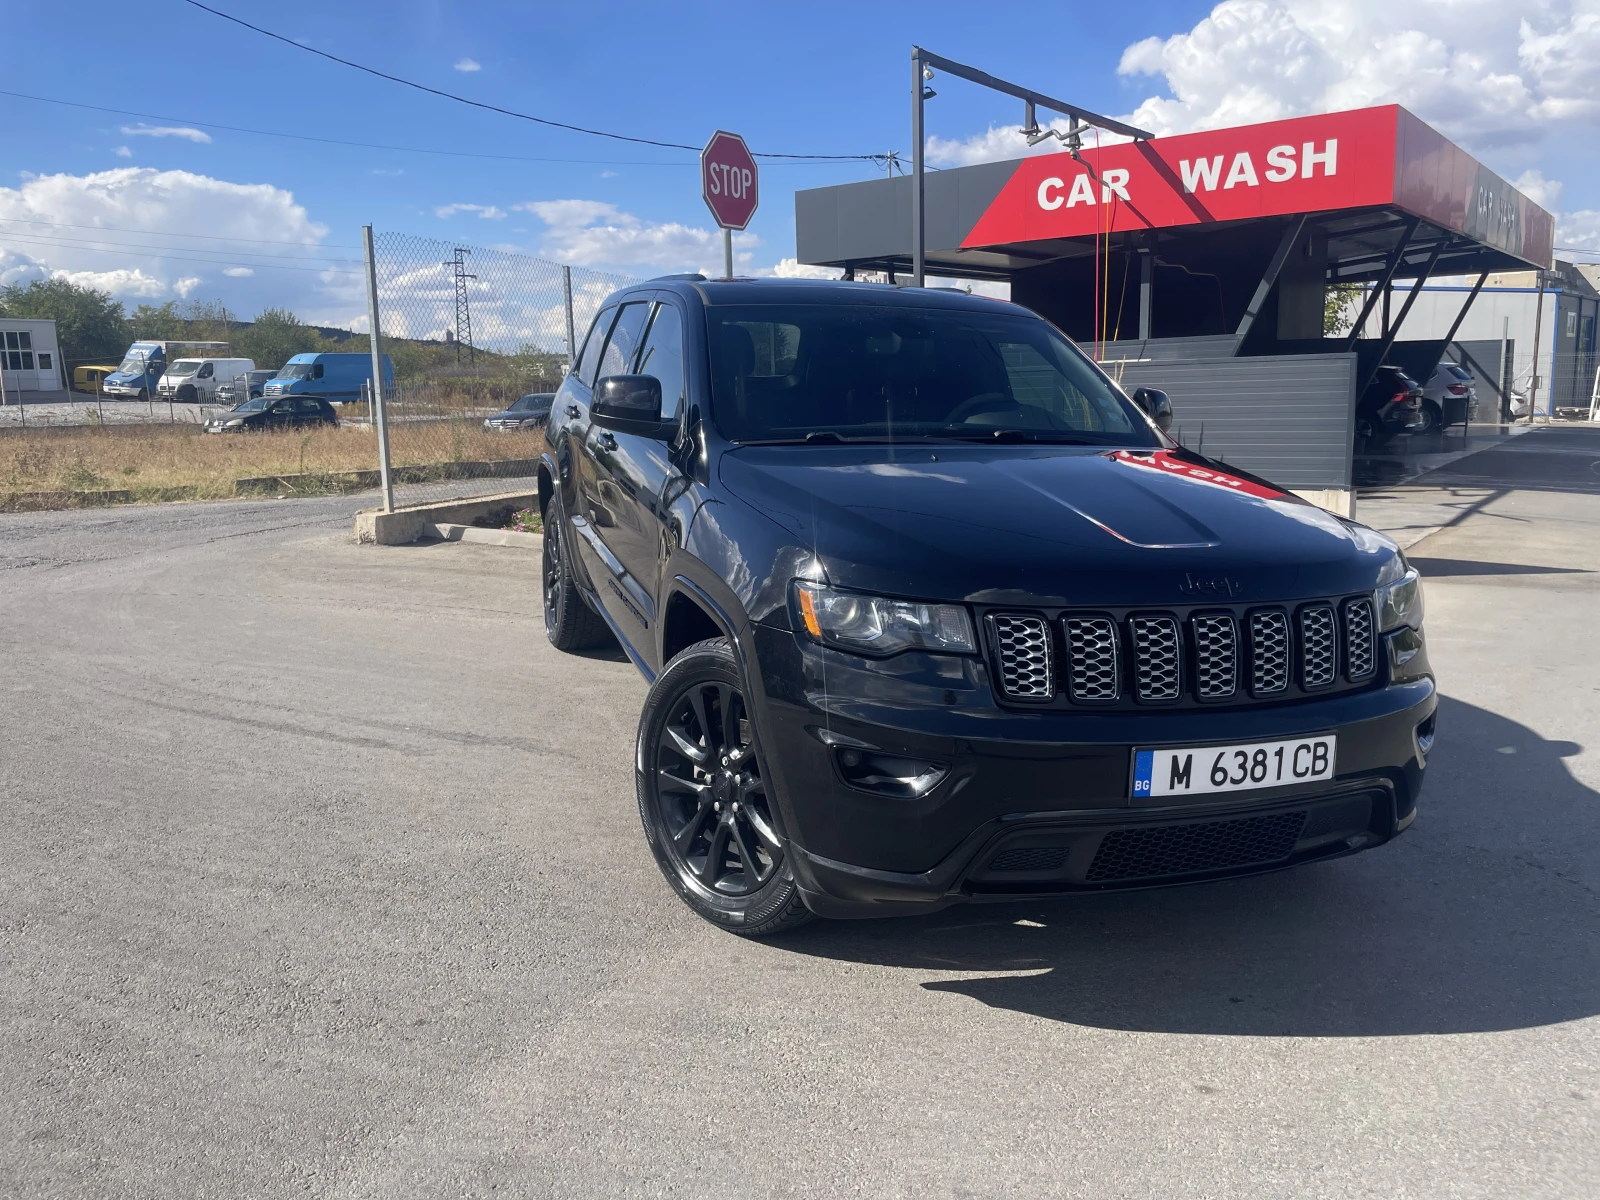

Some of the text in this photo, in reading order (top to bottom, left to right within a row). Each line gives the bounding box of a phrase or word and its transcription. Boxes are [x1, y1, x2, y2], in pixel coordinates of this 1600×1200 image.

[710, 161, 752, 200] STOP
[1037, 138, 1338, 211] CAR WASH
[1478, 185, 1493, 220] CAR
[1134, 780, 1150, 791] BG
[1169, 753, 1193, 790] M
